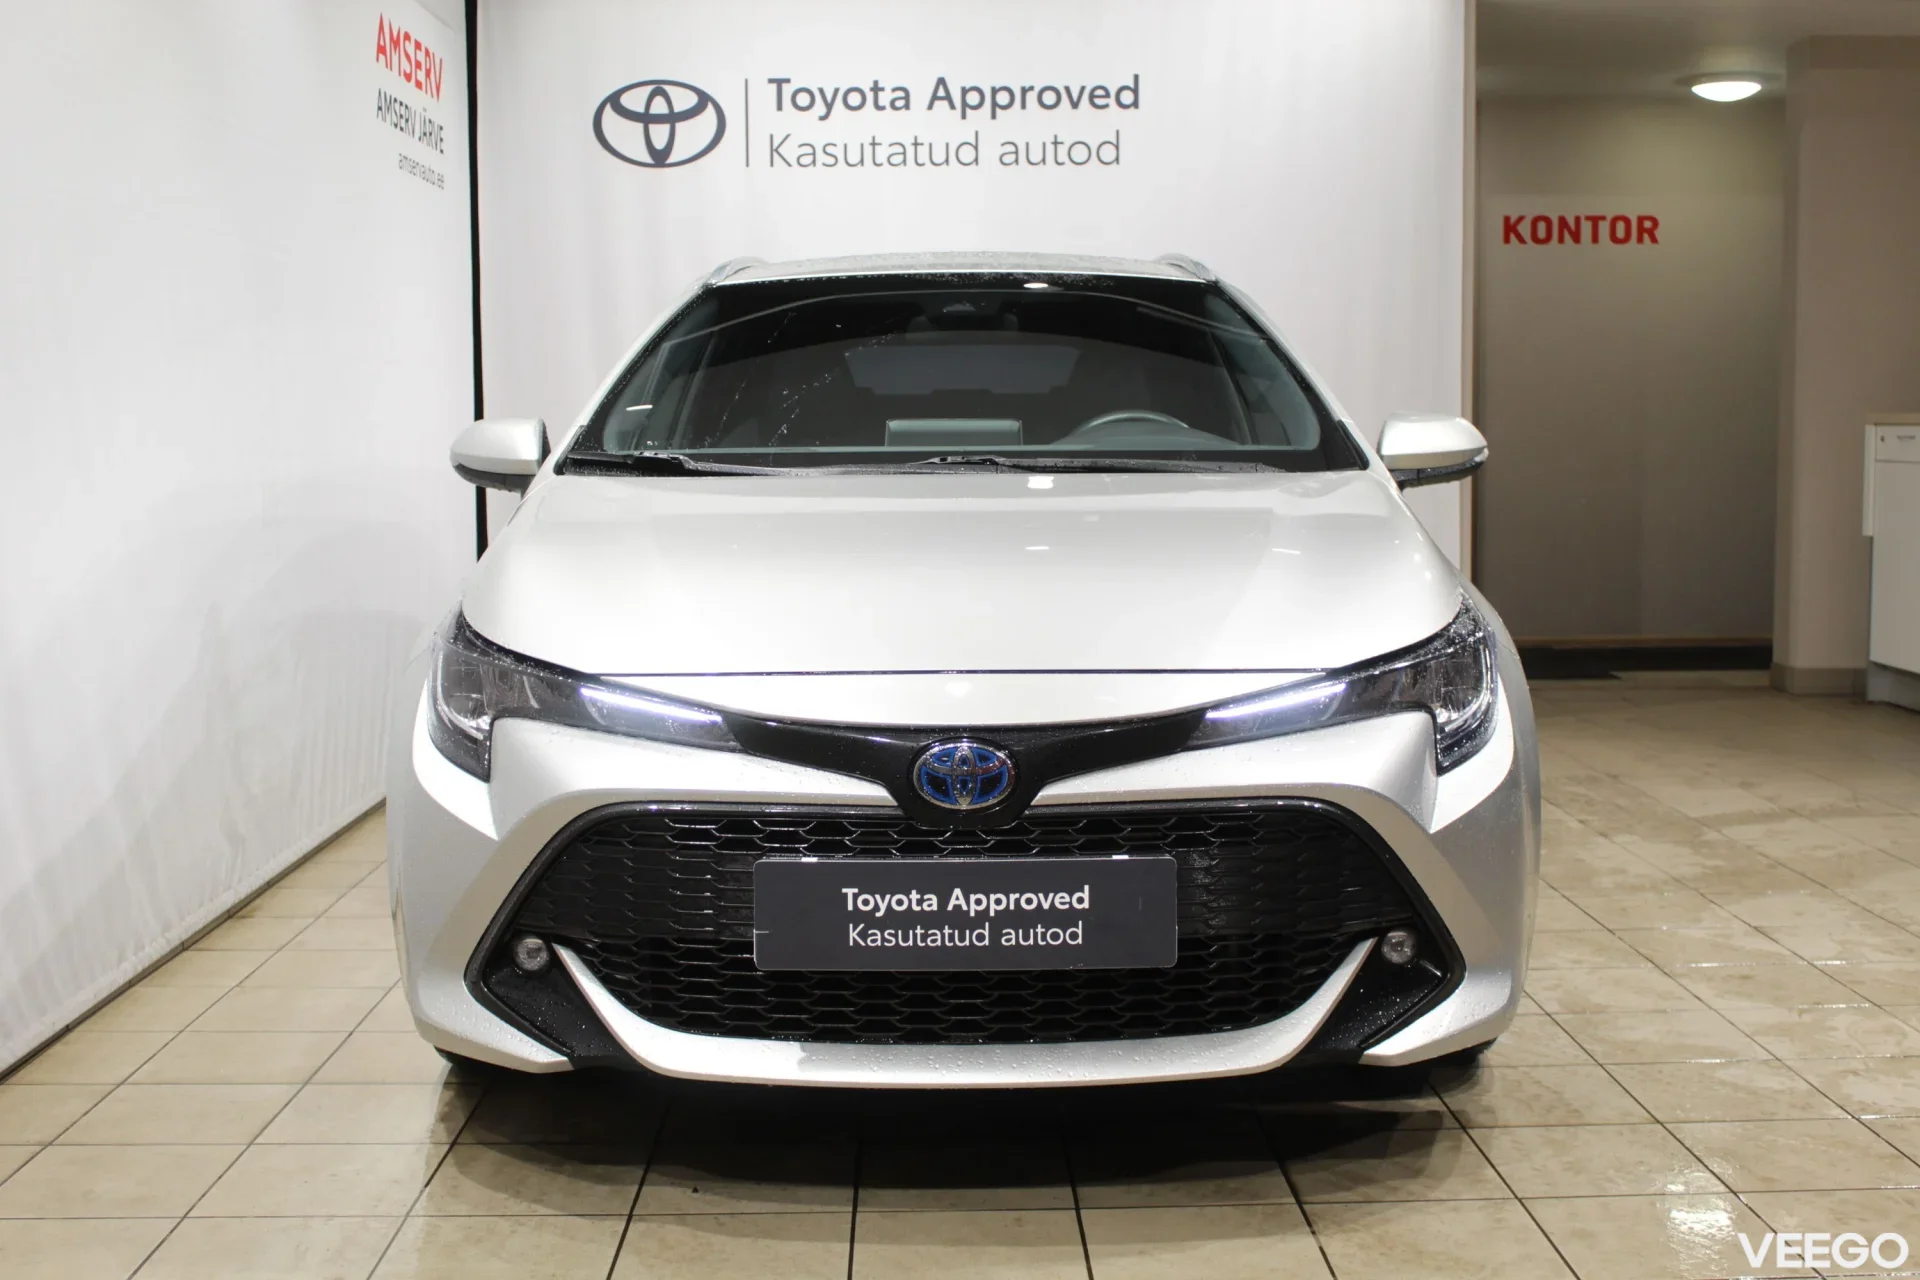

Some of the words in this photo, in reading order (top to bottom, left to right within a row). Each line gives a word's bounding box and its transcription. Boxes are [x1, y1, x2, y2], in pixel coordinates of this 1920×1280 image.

[376, 12, 443, 103] AMSERV
[767, 77, 910, 121] Toyota
[926, 73, 1140, 120] Approved
[376, 87, 417, 139] AMSERV
[418, 106, 444, 154] JÄRVE
[768, 130, 979, 168] Kasutatud
[998, 129, 1121, 167] autod
[398, 153, 445, 190] amservauto.ee
[1503, 214, 1660, 245] KONTOR
[842, 887, 938, 917] Toyota
[947, 885, 1090, 916] Approved
[848, 922, 990, 946] Kasutatud
[1000, 921, 1083, 946] autod
